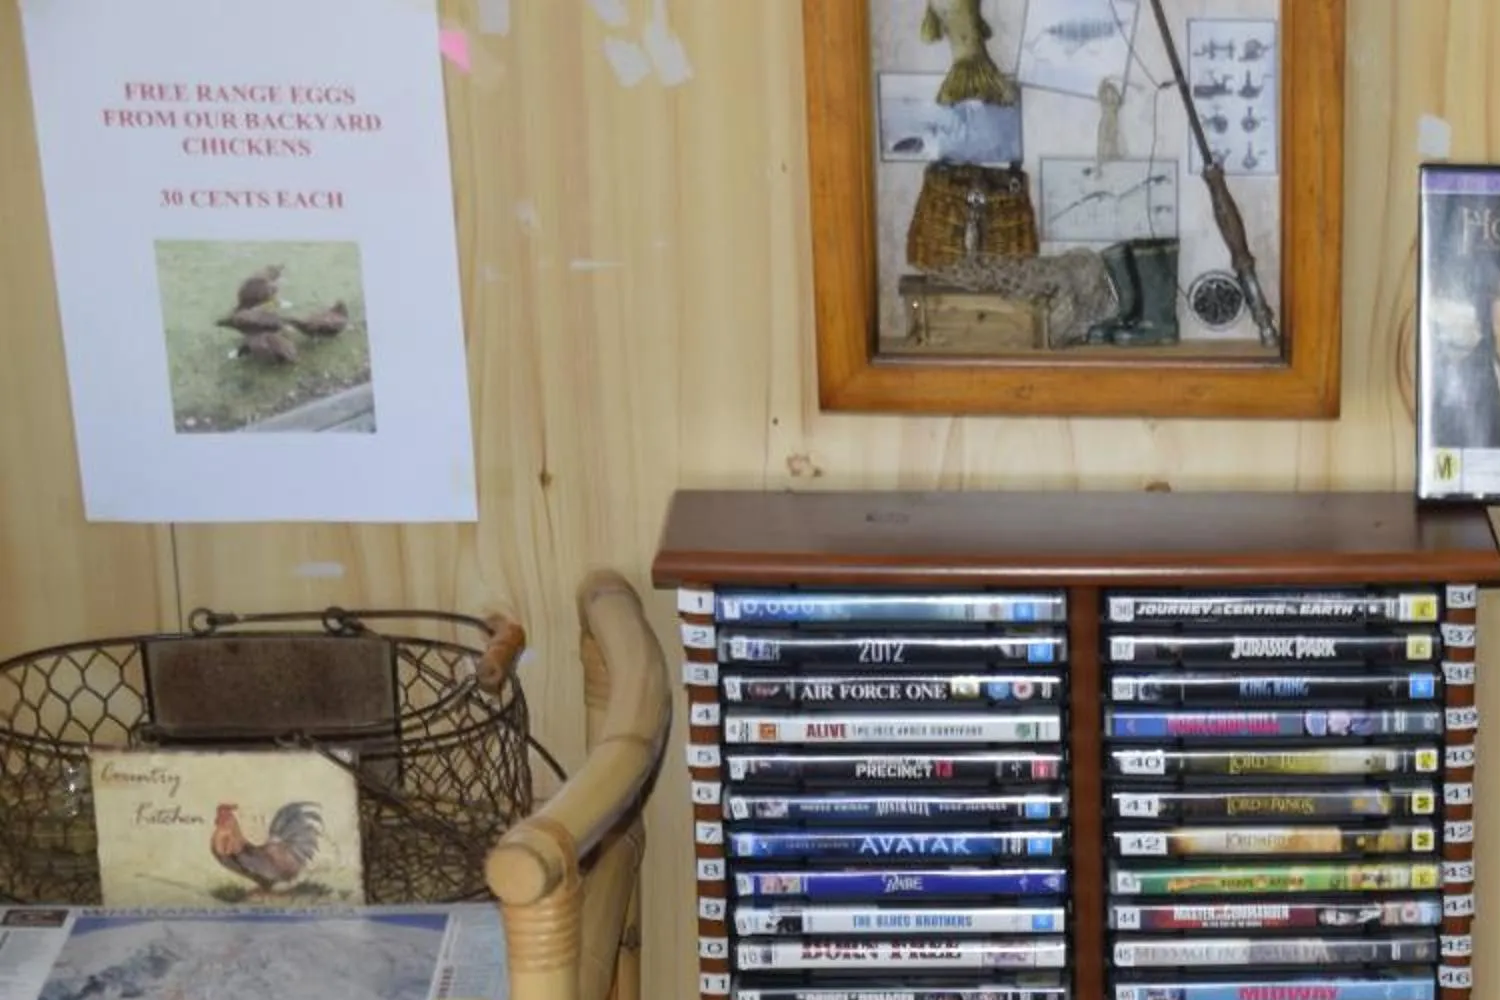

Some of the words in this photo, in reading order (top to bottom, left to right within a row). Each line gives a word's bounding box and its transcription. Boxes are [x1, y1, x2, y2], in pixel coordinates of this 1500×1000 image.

[124, 82, 187, 101] FREE
[196, 84, 282, 103] RANGE
[291, 86, 356, 105] EGGS
[103, 110, 176, 127] FROM
[184, 111, 239, 129] OUR
[245, 113, 382, 132] BACKYARD
[182, 137, 313, 156] CHICKENS
[160, 189, 184, 207] 30
[189, 190, 270, 208] CENTS
[277, 191, 345, 209] EACH
[1434, 455, 1453, 480] M
[1136, 603, 1213, 616] JOURNEY
[1223, 603, 1287, 616] CENTRE
[1299, 603, 1354, 616] EARTH
[859, 641, 905, 663] 2012
[1230, 637, 1293, 658] JURASSIC
[1296, 637, 1336, 658] PARK
[801, 684, 834, 699] AIR
[840, 684, 901, 699] FORCE
[906, 684, 947, 699] ONE
[806, 723, 847, 739] ALIVE
[100, 762, 183, 796] Country
[855, 763, 932, 779] PRECINCT
[135, 803, 207, 829] Kitchen
[860, 837, 972, 854] AVATAR
[853, 915, 870, 928] THE
[876, 915, 906, 927] BLUES
[915, 915, 973, 927] BROTHERS
